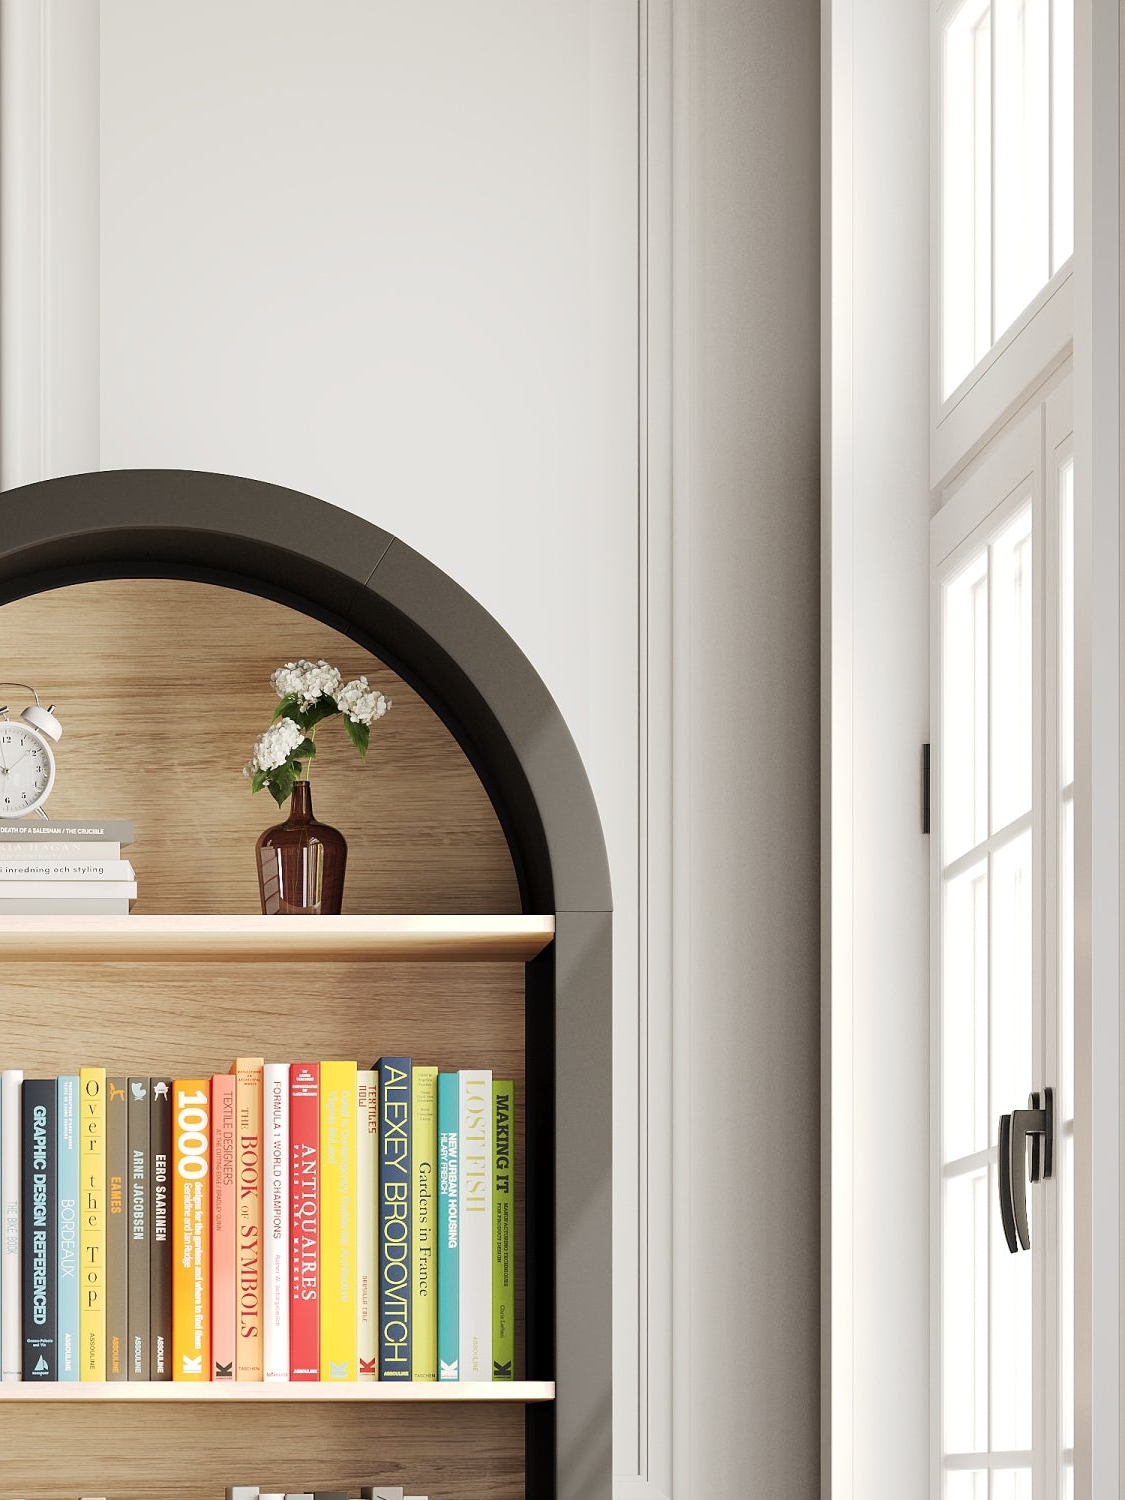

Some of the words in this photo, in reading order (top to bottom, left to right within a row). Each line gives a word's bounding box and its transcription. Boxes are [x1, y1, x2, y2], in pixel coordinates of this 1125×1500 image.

[73, 866, 104, 874] styling
[85, 1080, 100, 1152] Over
[223, 1091, 233, 1130] TEXTILE
[241, 1107, 249, 1130] THE
[273, 1081, 282, 1130] FORMULA
[368, 1085, 376, 1134] TEXTILES
[384, 1065, 408, 1173] ALEXEY
[465, 1079, 486, 1148] LOST
[496, 1094, 509, 1170] MAKING
[33, 1105, 47, 1170] GRAPHIC
[177, 1089, 208, 1180] 1000
[223, 1131, 233, 1185] DESIGNERS
[273, 1140, 282, 1177] WORLD
[448, 1133, 457, 1158] NEW
[133, 1150, 144, 1179] ARNE
[155, 1154, 166, 1184] EERO
[241, 1136, 258, 1200] BOOK
[448, 1159, 457, 1197] URBAN
[465, 1155, 486, 1214] FISH
[496, 1174, 509, 1194] IT
[33, 1173, 47, 1226] DESIGN
[87, 1175, 97, 1227] the
[110, 1176, 122, 1214] EAMES
[133, 1183, 144, 1240] JACOBSEN
[155, 1186, 166, 1241] SAARINEN
[241, 1205, 249, 1220] OF
[273, 1179, 282, 1239] CHAMPIONS
[419, 1162, 431, 1224] Gardens
[61, 1200, 75, 1278] BORDEAUX
[298, 1144, 317, 1300] ANTIQUAIRES
[419, 1228, 431, 1242] in
[448, 1199, 457, 1248] HOUSING
[33, 1230, 47, 1325] REFERENCED
[86, 1245, 99, 1308] Top
[240, 1225, 258, 1338] SYMBOLS
[384, 1183, 408, 1362] BRODOVITCH
[419, 1247, 431, 1297] France
